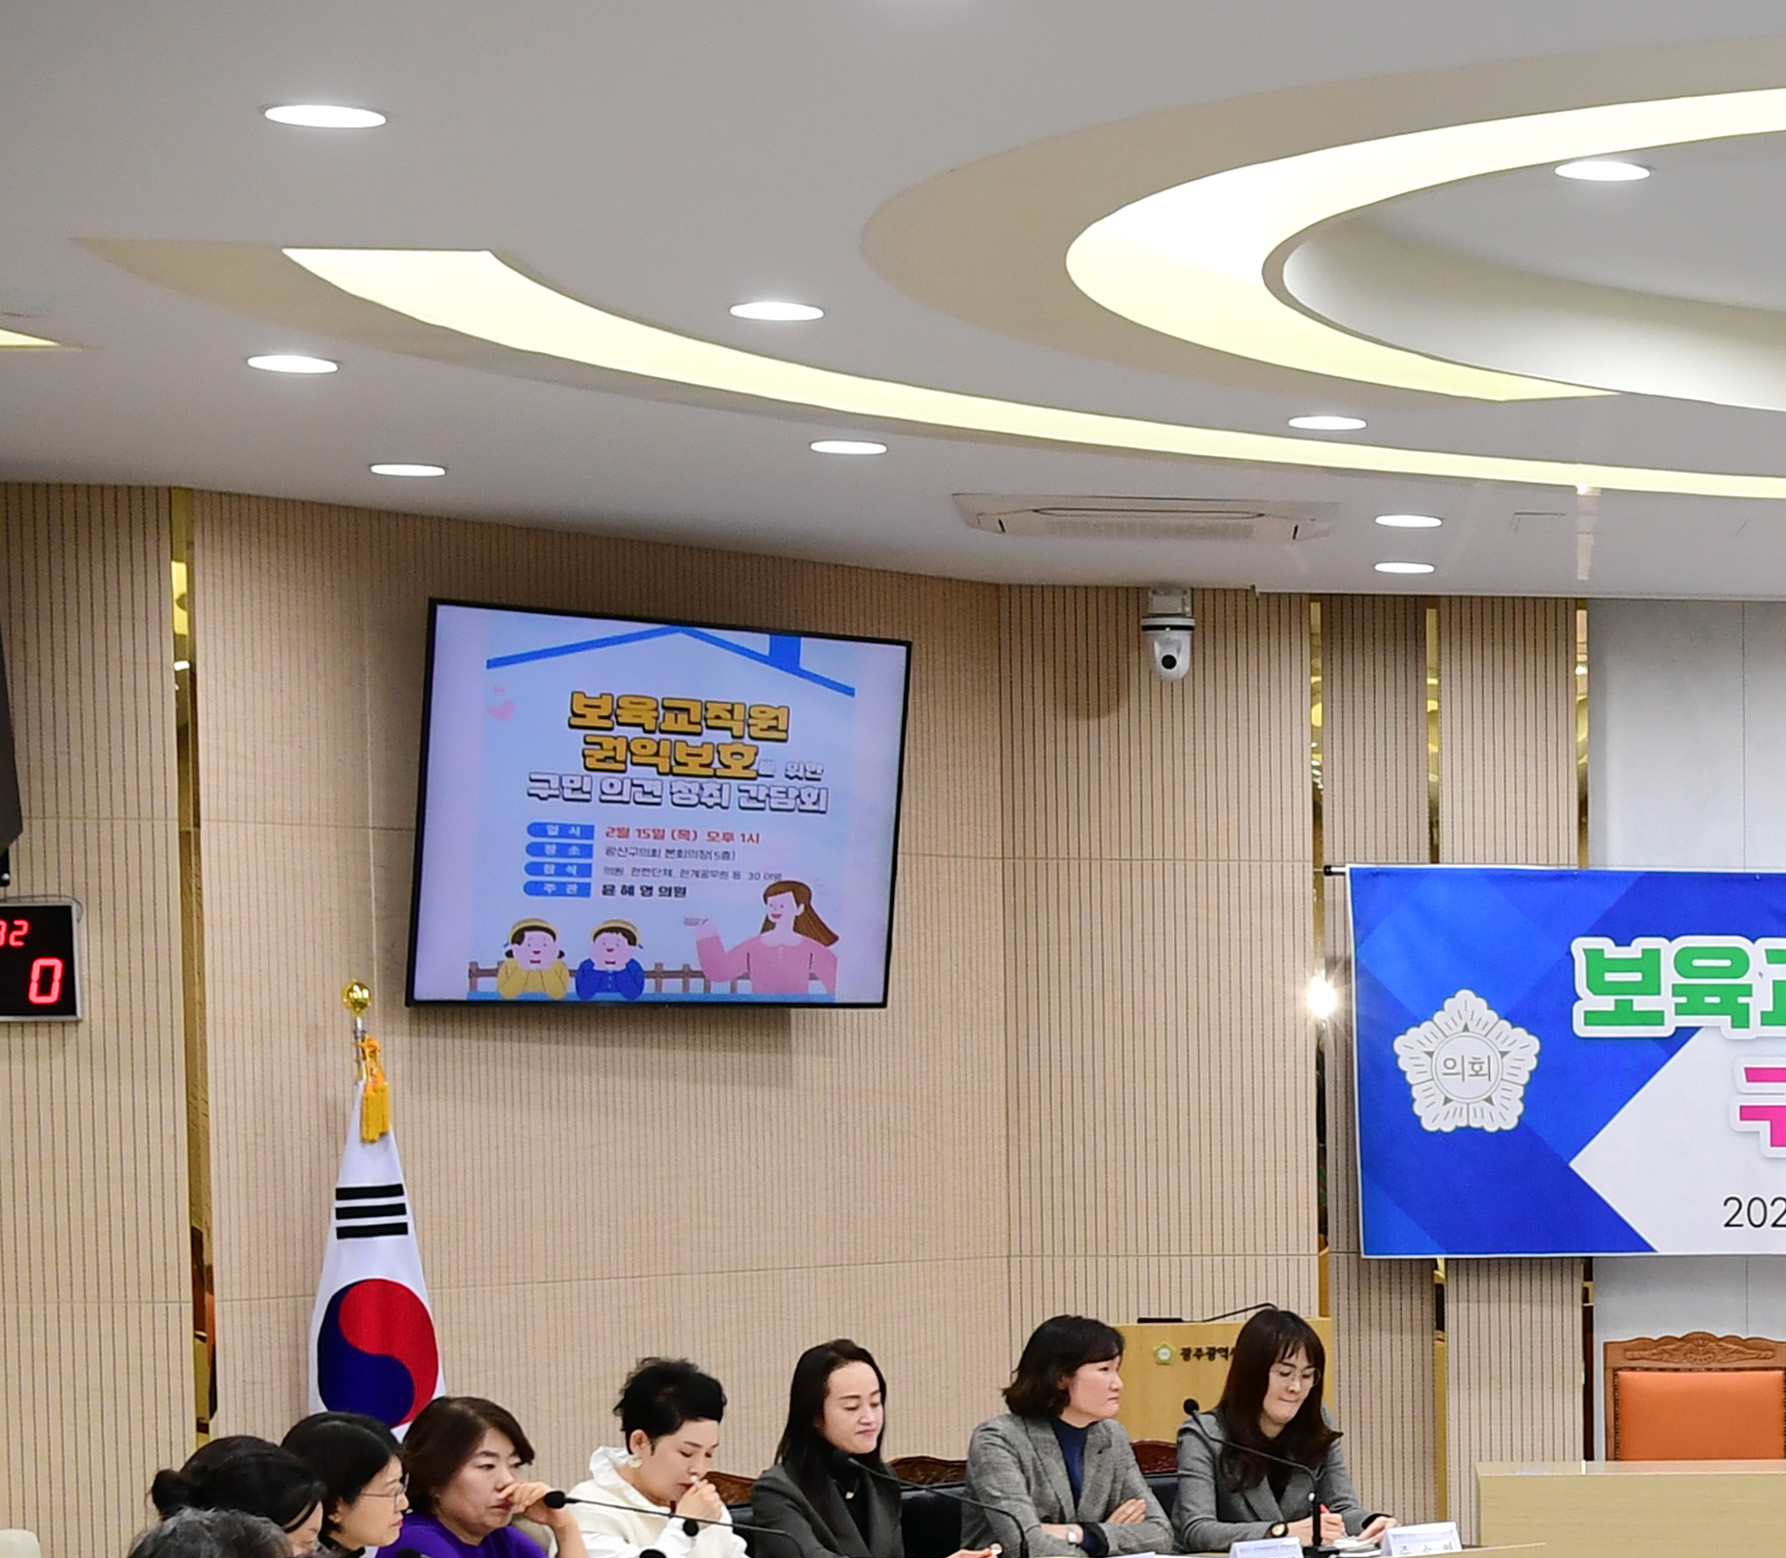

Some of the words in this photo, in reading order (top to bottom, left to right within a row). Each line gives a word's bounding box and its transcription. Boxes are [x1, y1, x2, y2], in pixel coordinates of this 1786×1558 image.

[568, 691, 790, 742] 보육교직원
[527, 772, 592, 801] 구민
[738, 783, 828, 813] 간담회
[28, 958, 63, 1004] 0
[1442, 1055, 1491, 1082] 의회
